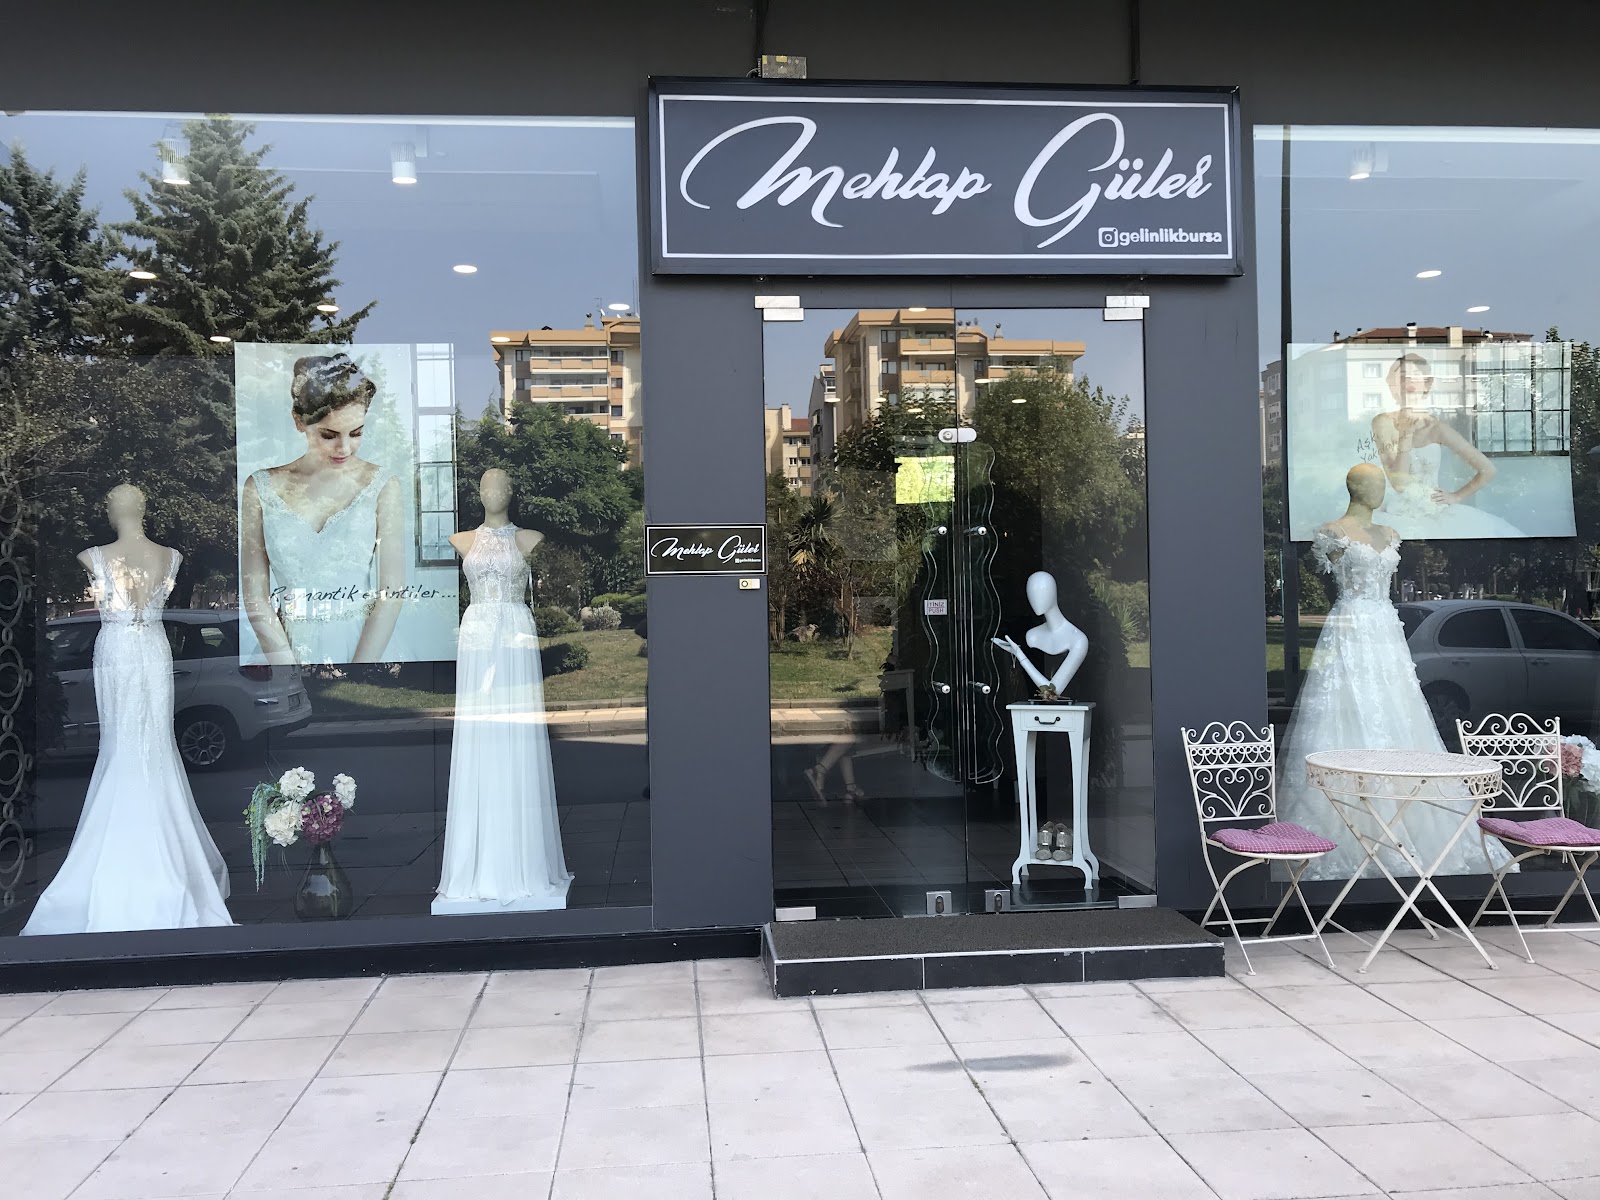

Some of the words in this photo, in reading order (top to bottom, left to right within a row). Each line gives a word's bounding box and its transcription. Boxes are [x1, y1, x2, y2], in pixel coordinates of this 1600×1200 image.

[680, 116, 993, 228] Mehtap
[1013, 112, 1212, 249] Güler
[1119, 228, 1222, 246] gelinlikbursa
[717, 535, 760, 564] Güler
